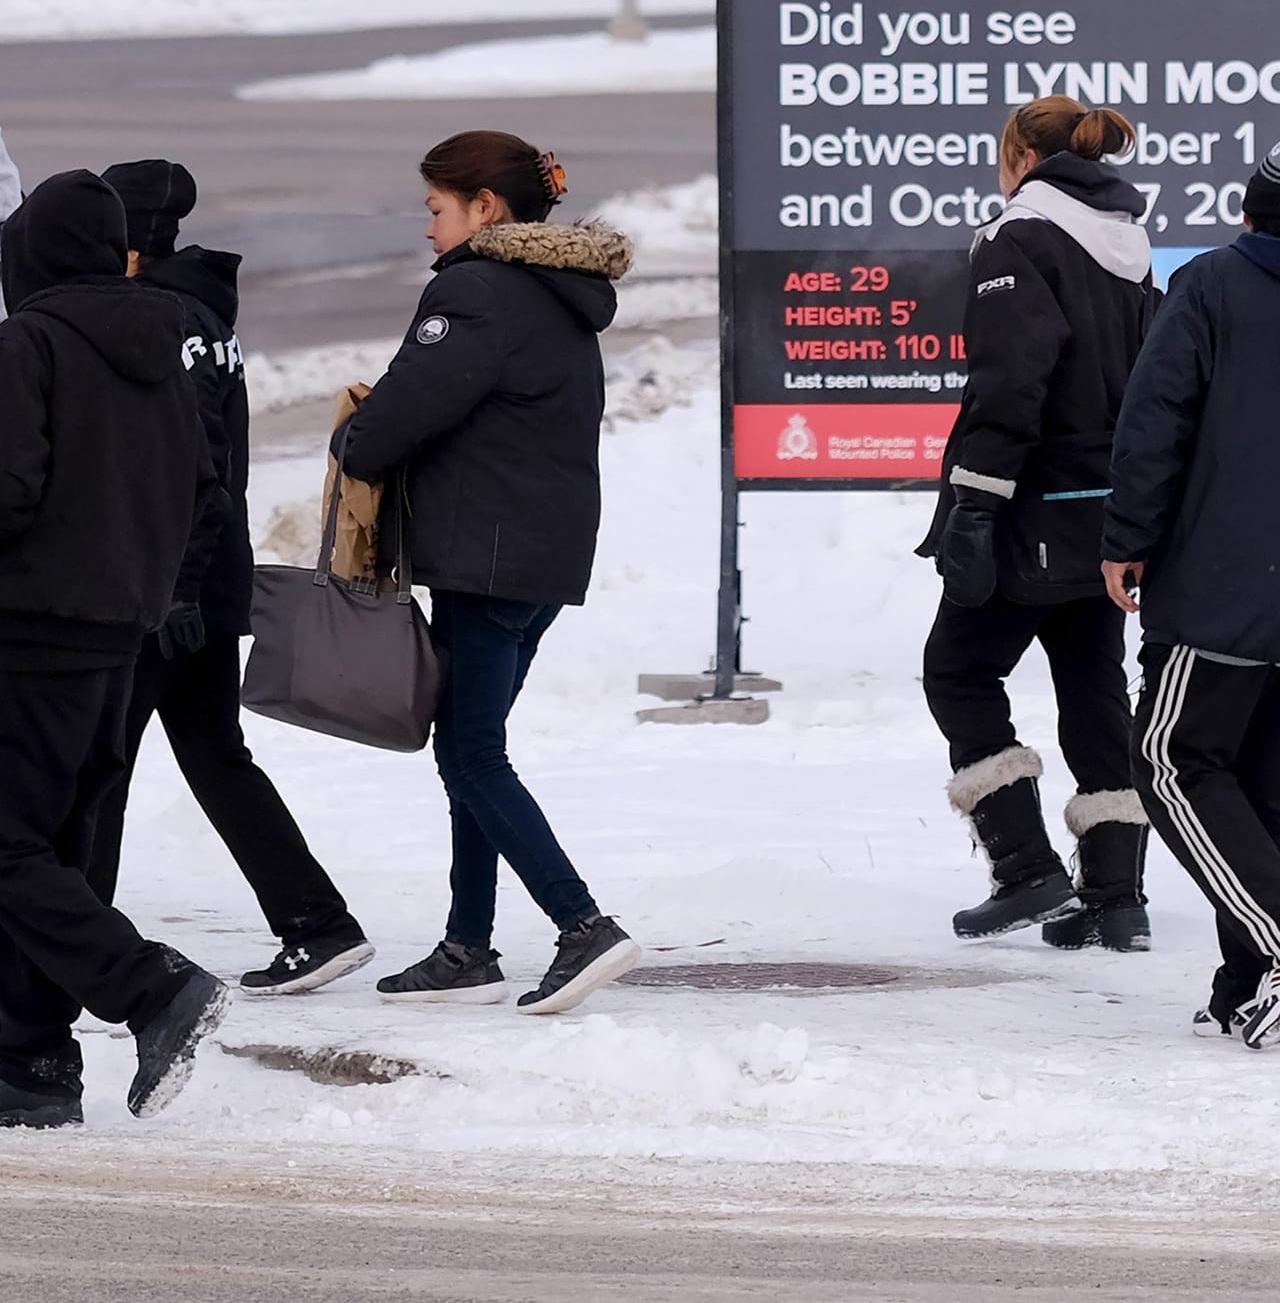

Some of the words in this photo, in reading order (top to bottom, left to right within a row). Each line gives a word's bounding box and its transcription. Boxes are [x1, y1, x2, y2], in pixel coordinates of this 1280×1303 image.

[780, 0, 863, 45] Did
[877, 12, 970, 56] you
[986, 11, 1076, 45] see
[780, 62, 988, 106] BOBBIE
[1004, 62, 1147, 105] LYNN
[780, 124, 998, 167] between
[1233, 121, 1255, 165] 1
[779, 184, 872, 227] and
[784, 272, 842, 292] AGE:
[850, 266, 889, 292] 29
[977, 275, 1016, 296] FXR
[784, 306, 882, 326] HEIGHT:
[784, 340, 887, 360] WEIGHT:
[895, 335, 941, 360] 110
[784, 372, 822, 389] Last
[825, 375, 868, 389] seen
[870, 371, 942, 392] wearing
[829, 437, 861, 451] Royal
[864, 436, 916, 448] Canadian
[829, 448, 879, 459] Mounted
[881, 448, 915, 459] Police
